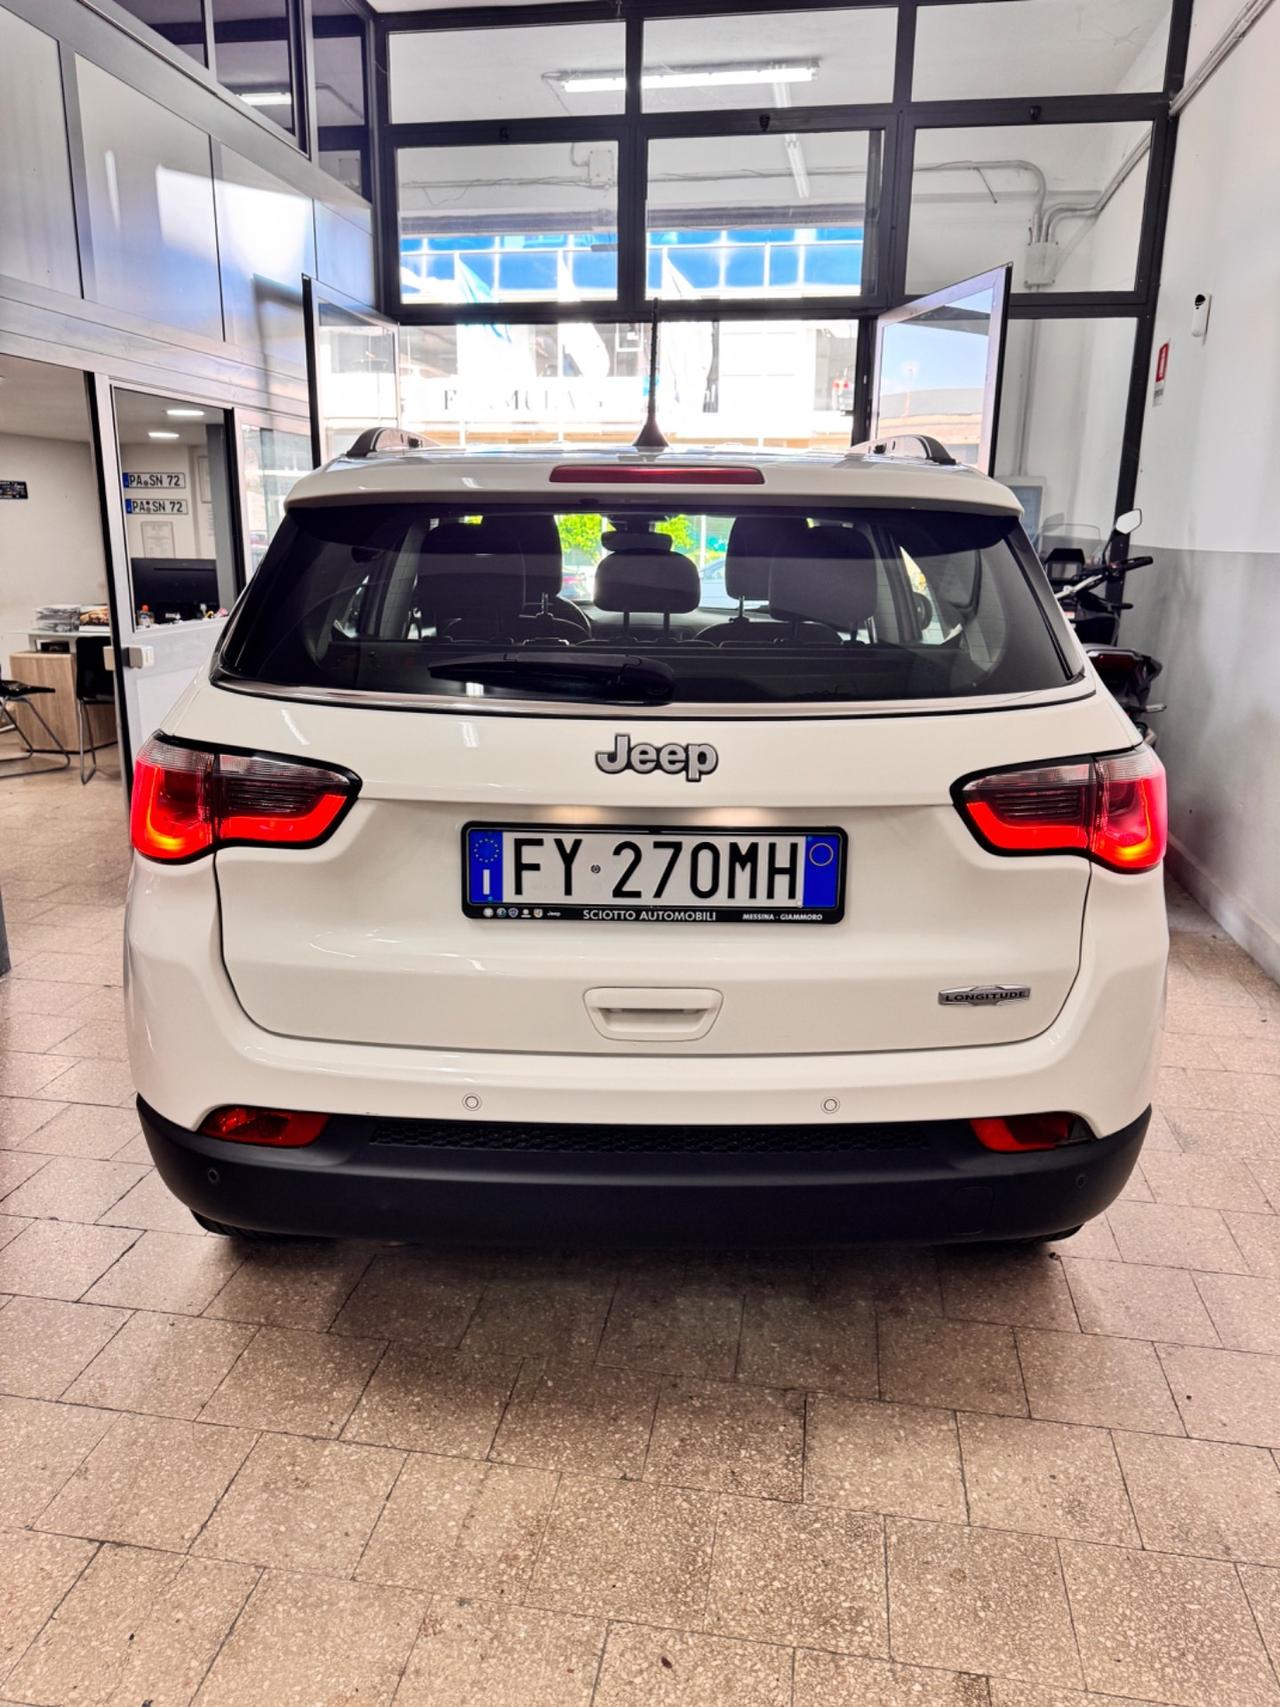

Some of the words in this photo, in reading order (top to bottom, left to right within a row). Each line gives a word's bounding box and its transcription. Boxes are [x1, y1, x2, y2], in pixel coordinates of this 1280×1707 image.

[129, 474, 143, 486] PA
[149, 474, 163, 486] SN
[167, 474, 181, 486] 72
[132, 500, 146, 512] PA
[152, 500, 166, 513] SN
[169, 501, 183, 513] 72
[595, 733, 719, 782] Jeep
[514, 838, 583, 896] FY
[612, 840, 798, 899] 270MH
[583, 910, 636, 920] SCIOTTO
[639, 911, 716, 921] AUTOMOBILI
[742, 913, 775, 921] MESSINA
[780, 913, 823, 921] GIAMMORO
[945, 991, 1026, 1002] LONGITUDE
